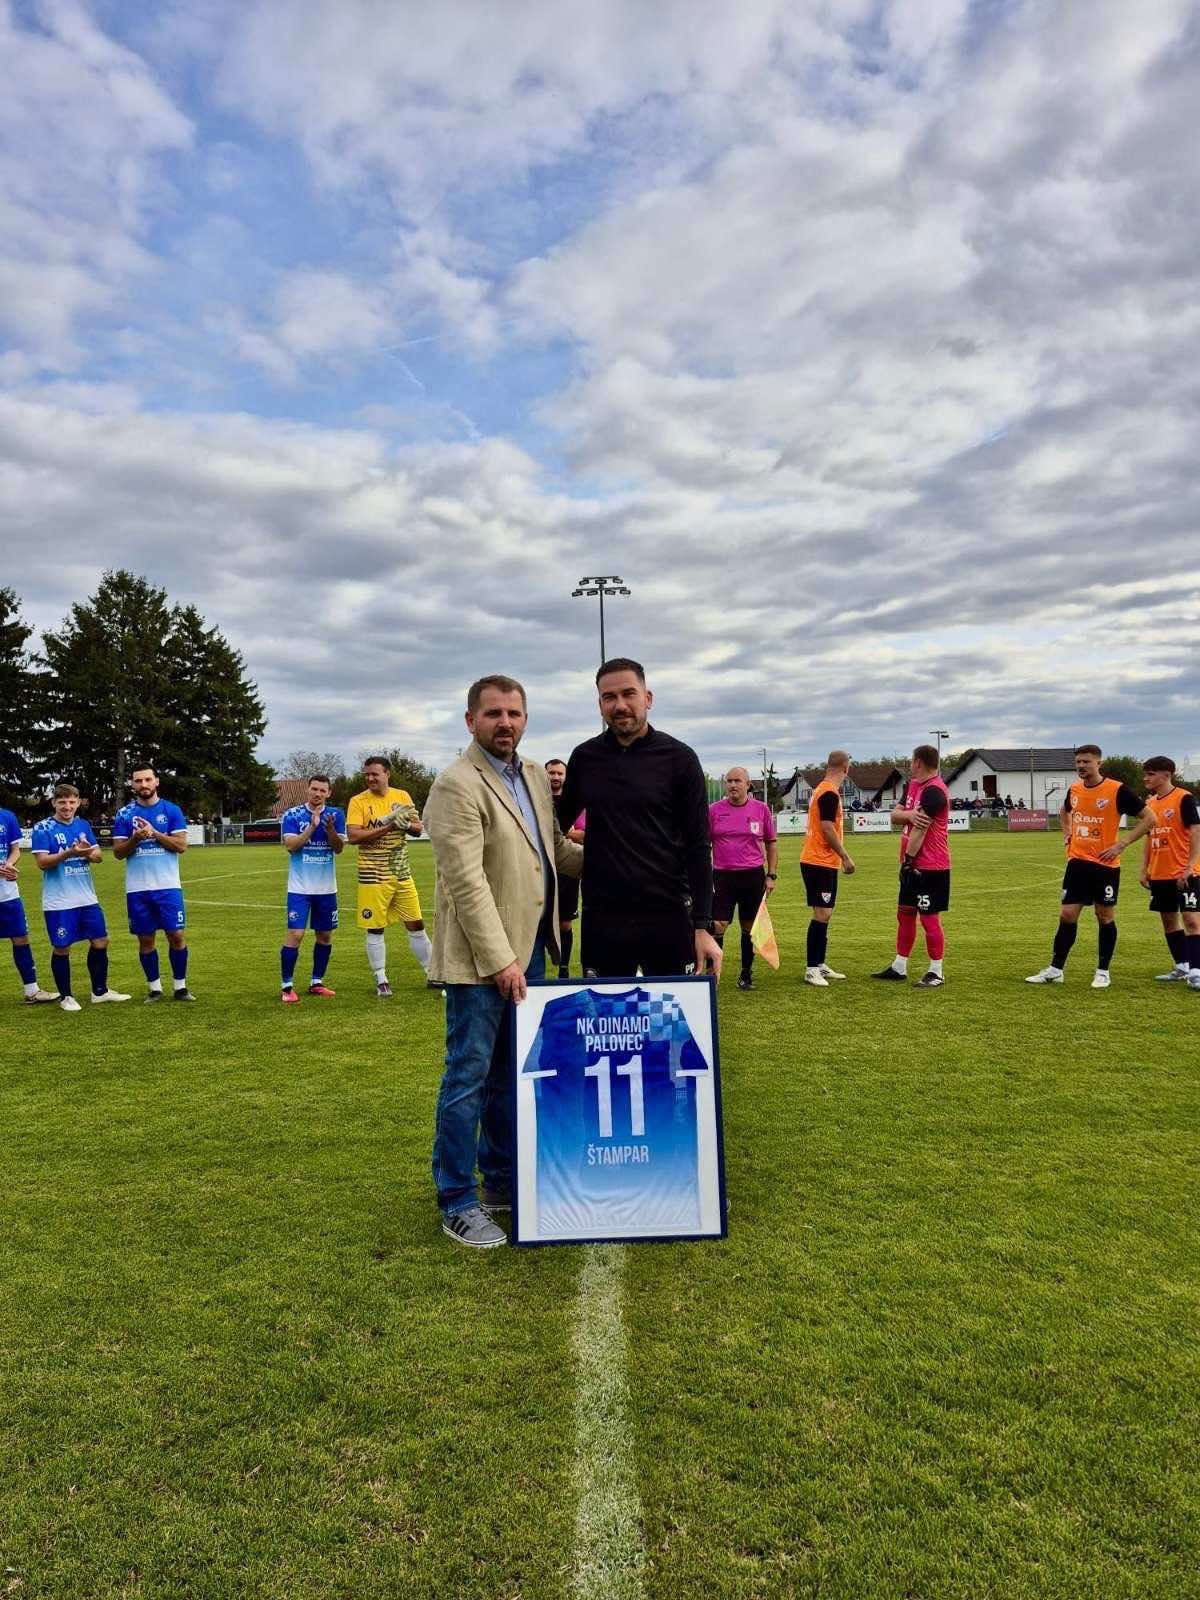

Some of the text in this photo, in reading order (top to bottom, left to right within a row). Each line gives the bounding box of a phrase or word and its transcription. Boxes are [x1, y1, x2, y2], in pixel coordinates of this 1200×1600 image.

[55, 833, 67, 844] 19
[1105, 885, 1113, 898] 9
[917, 895, 930, 907] 25
[1183, 892, 1197, 905] 14
[177, 911, 184, 922] 5
[685, 962, 695, 974] PP
[577, 1015, 650, 1035] NK DINAMO
[585, 1033, 644, 1052] PALOVEC
[584, 1055, 646, 1137] 11
[587, 1144, 649, 1165] ŠTAMPAR
